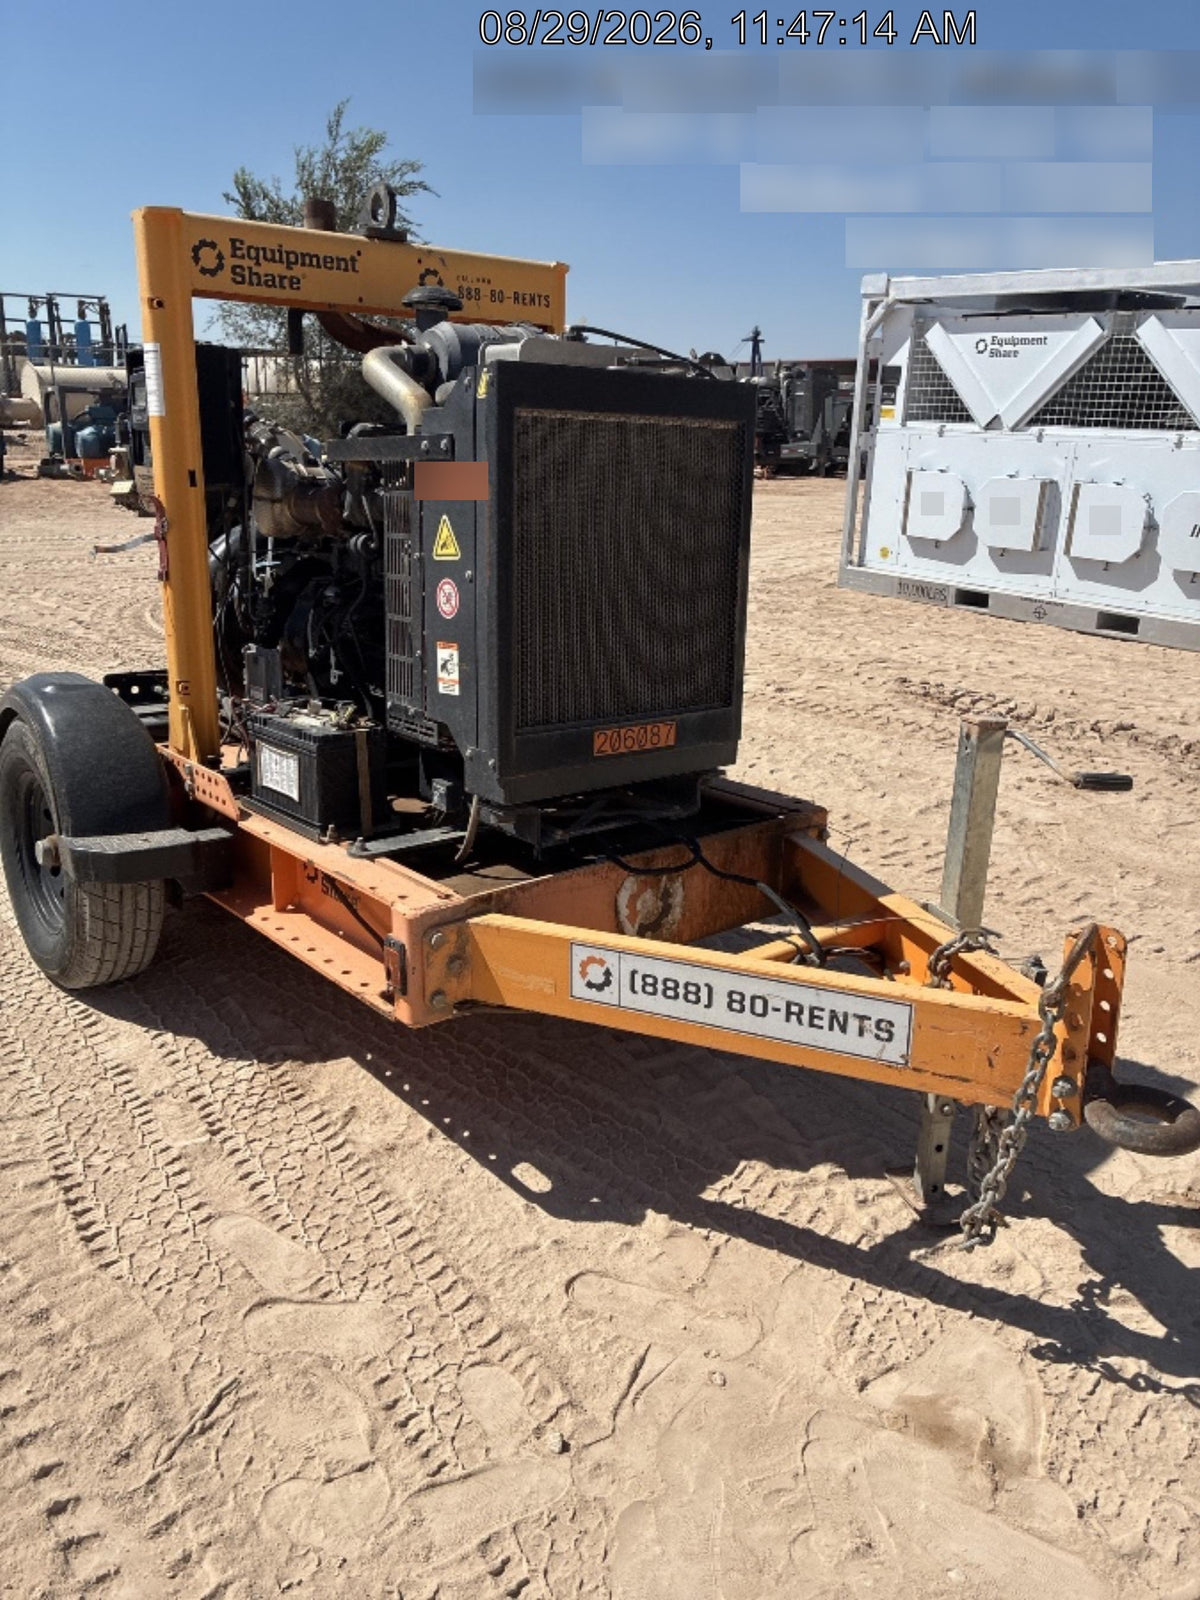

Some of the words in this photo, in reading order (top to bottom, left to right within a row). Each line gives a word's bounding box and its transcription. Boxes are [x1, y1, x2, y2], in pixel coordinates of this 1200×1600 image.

[229, 237, 359, 273] Equipment
[230, 264, 302, 291] Share
[989, 347, 1019, 358] Share
[990, 335, 1048, 348] Equipment
[596, 723, 675, 754] 206087
[629, 969, 714, 1008] (888)
[726, 989, 896, 1043] 80-RENTS
